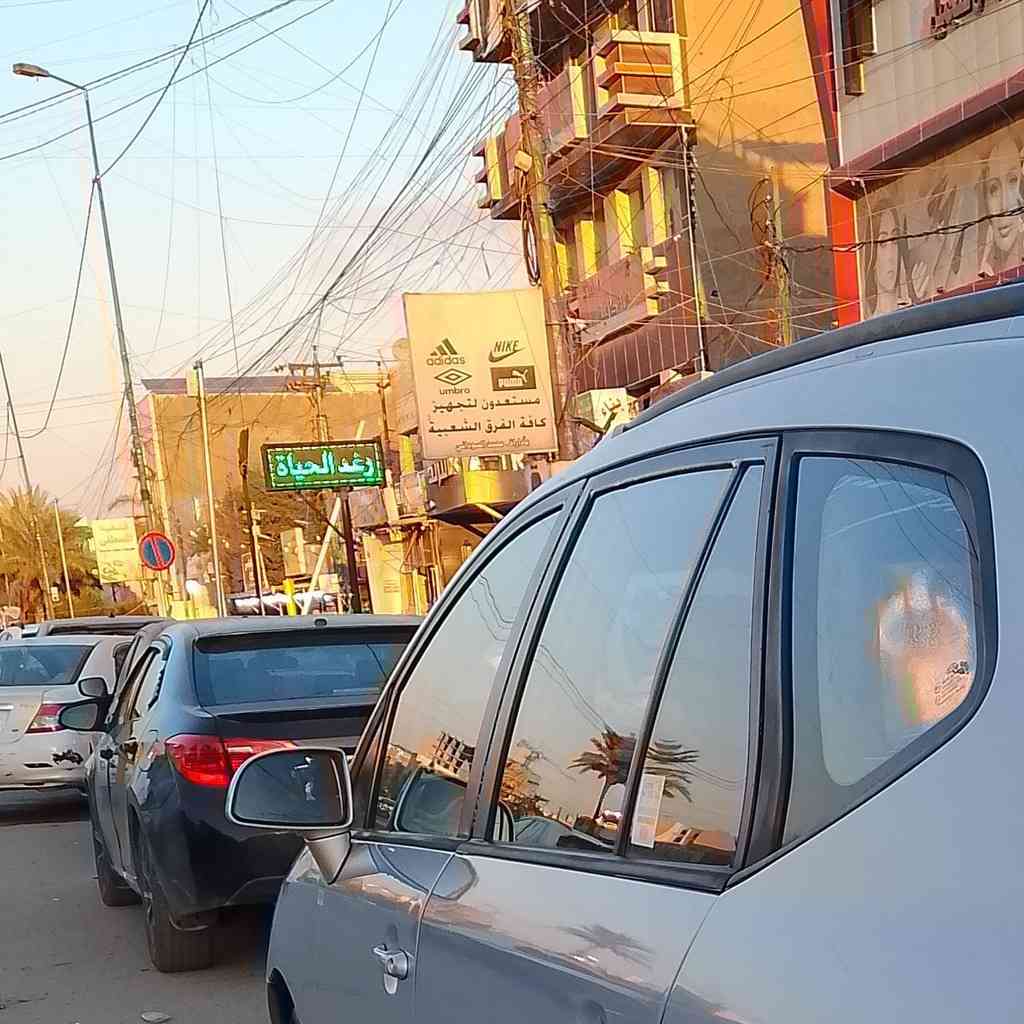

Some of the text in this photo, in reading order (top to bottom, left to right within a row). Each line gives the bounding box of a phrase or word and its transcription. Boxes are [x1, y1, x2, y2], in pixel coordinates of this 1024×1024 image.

[493, 340, 520, 353] NIKE
[426, 356, 466, 366] adidas
[439, 387, 470, 395] umbro
[432, 396, 540, 413] مستعدون لتجهيز
[428, 417, 546, 437] كافة الفرق الشعبية
[275, 449, 335, 481] الحياة
